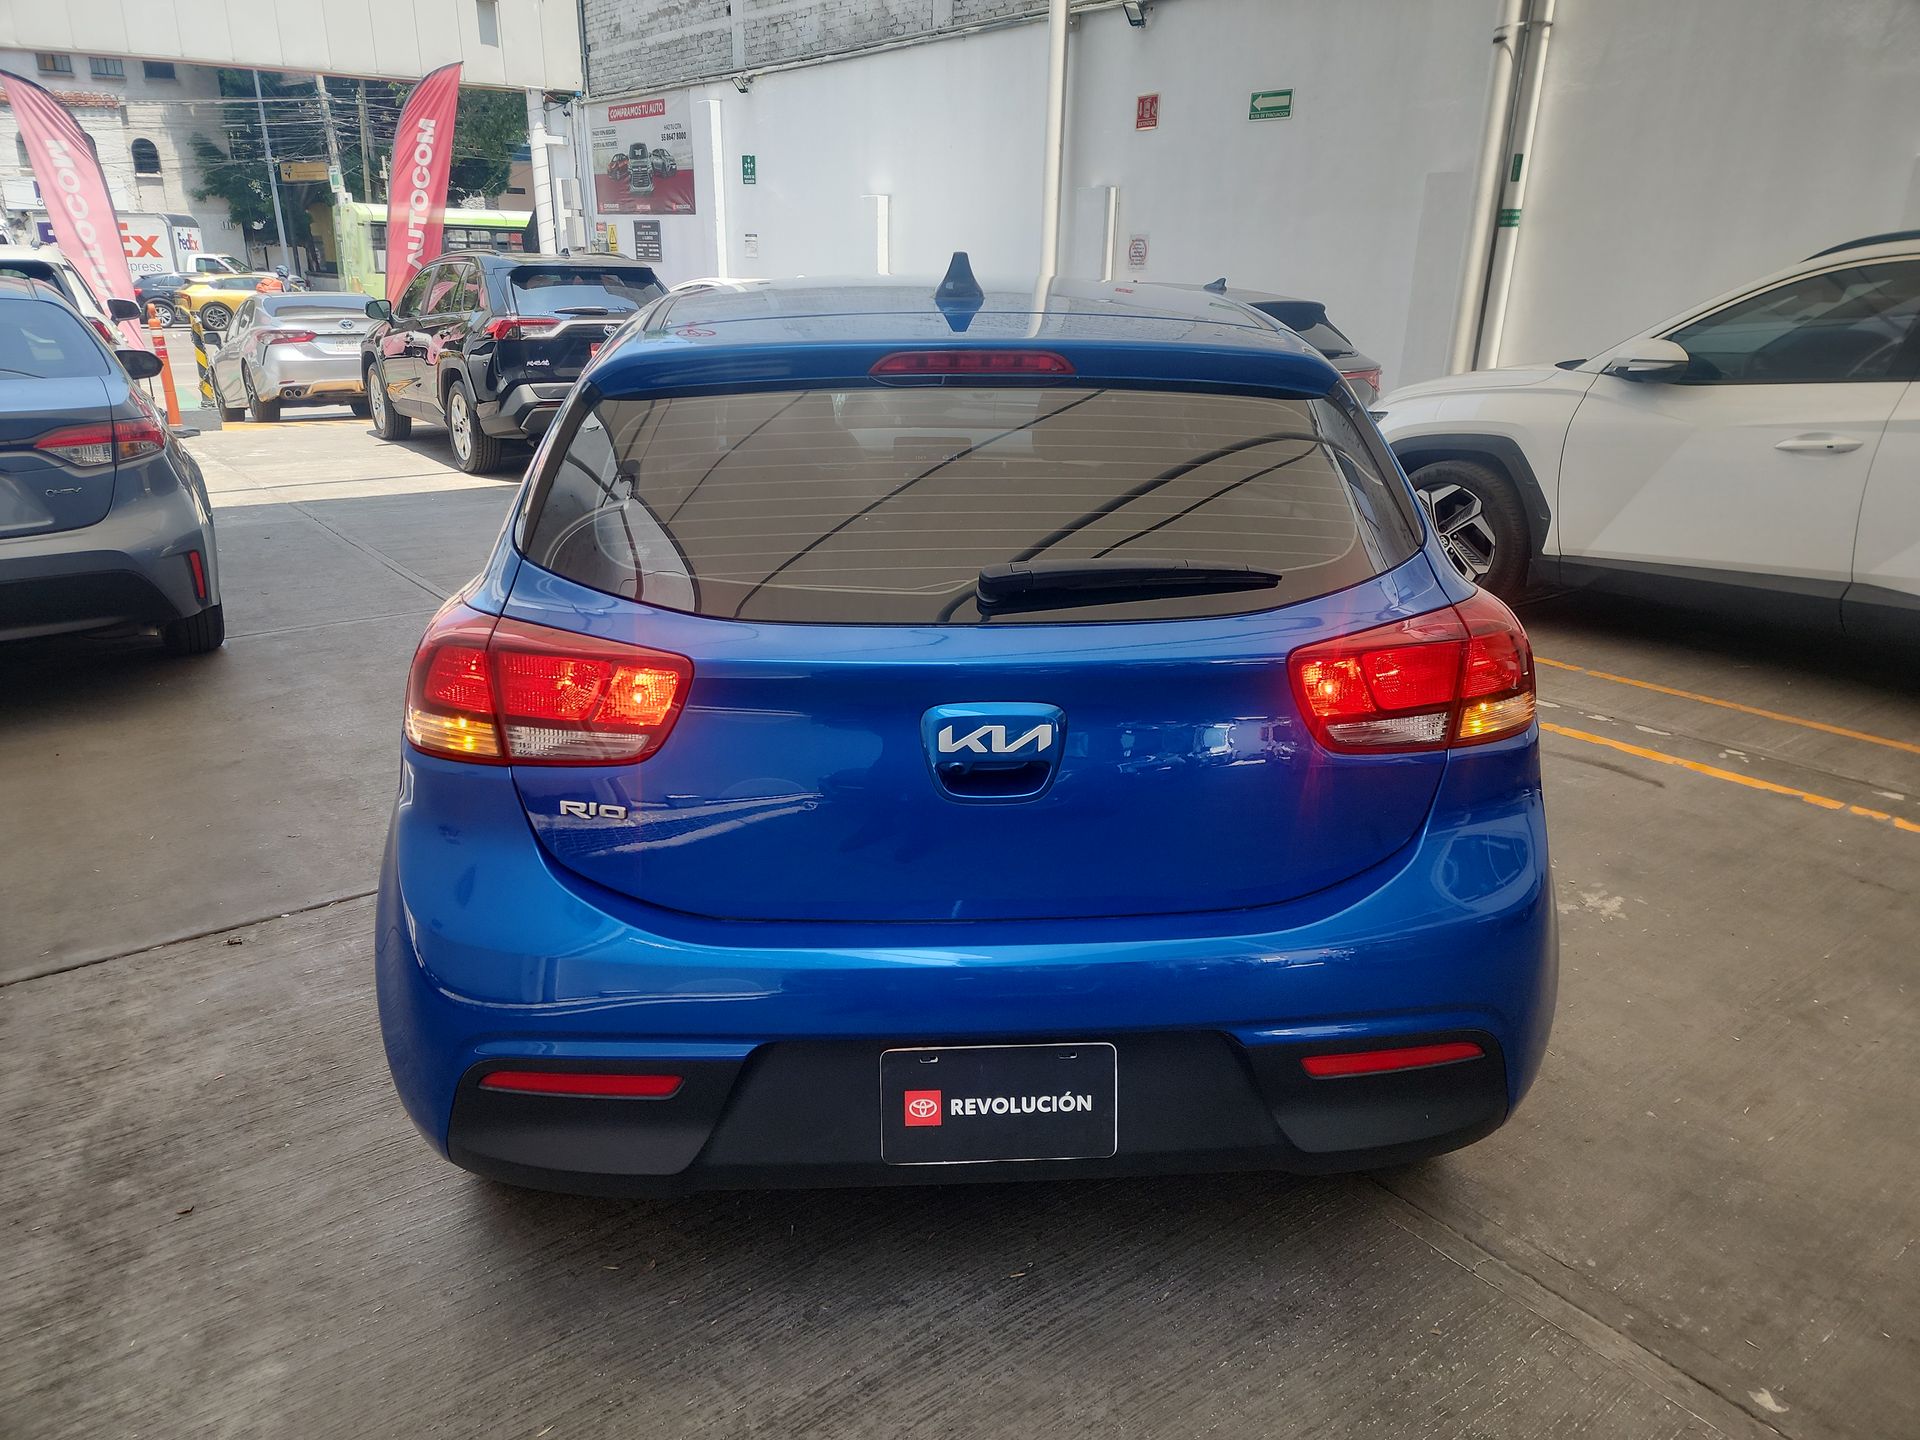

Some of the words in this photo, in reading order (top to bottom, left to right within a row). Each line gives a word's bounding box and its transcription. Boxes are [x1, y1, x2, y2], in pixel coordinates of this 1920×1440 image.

[609, 105, 641, 119] COMPRAMOS
[642, 104, 649, 115] TU
[649, 102, 664, 113] AUTO
[407, 118, 436, 270] AUTOCOM
[178, 232, 199, 251] FedEx
[938, 724, 1053, 753] KIA
[951, 1091, 1092, 1116] REVOLUCIÓN
